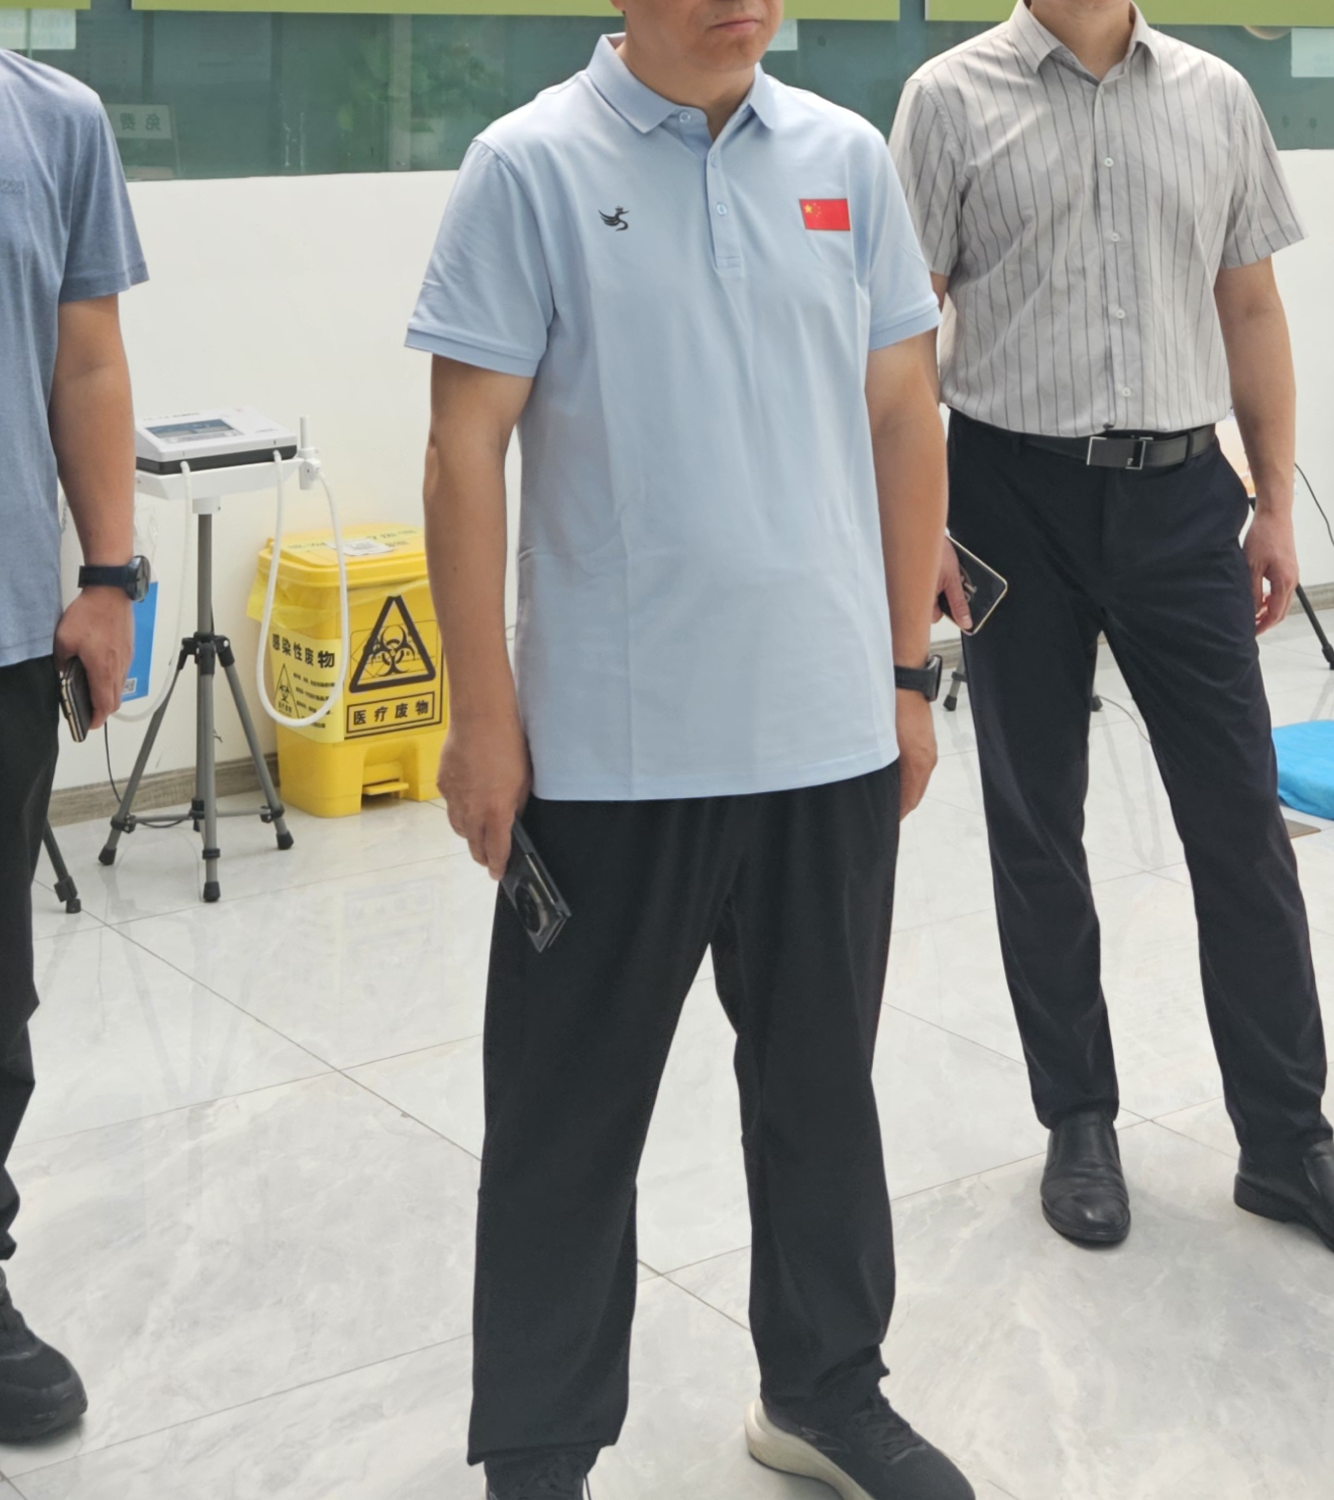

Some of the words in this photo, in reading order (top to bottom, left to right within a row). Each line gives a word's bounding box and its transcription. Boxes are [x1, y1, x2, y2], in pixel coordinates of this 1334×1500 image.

[272, 633, 335, 669] 感染性废物
[353, 700, 429, 725] 医疗废物
